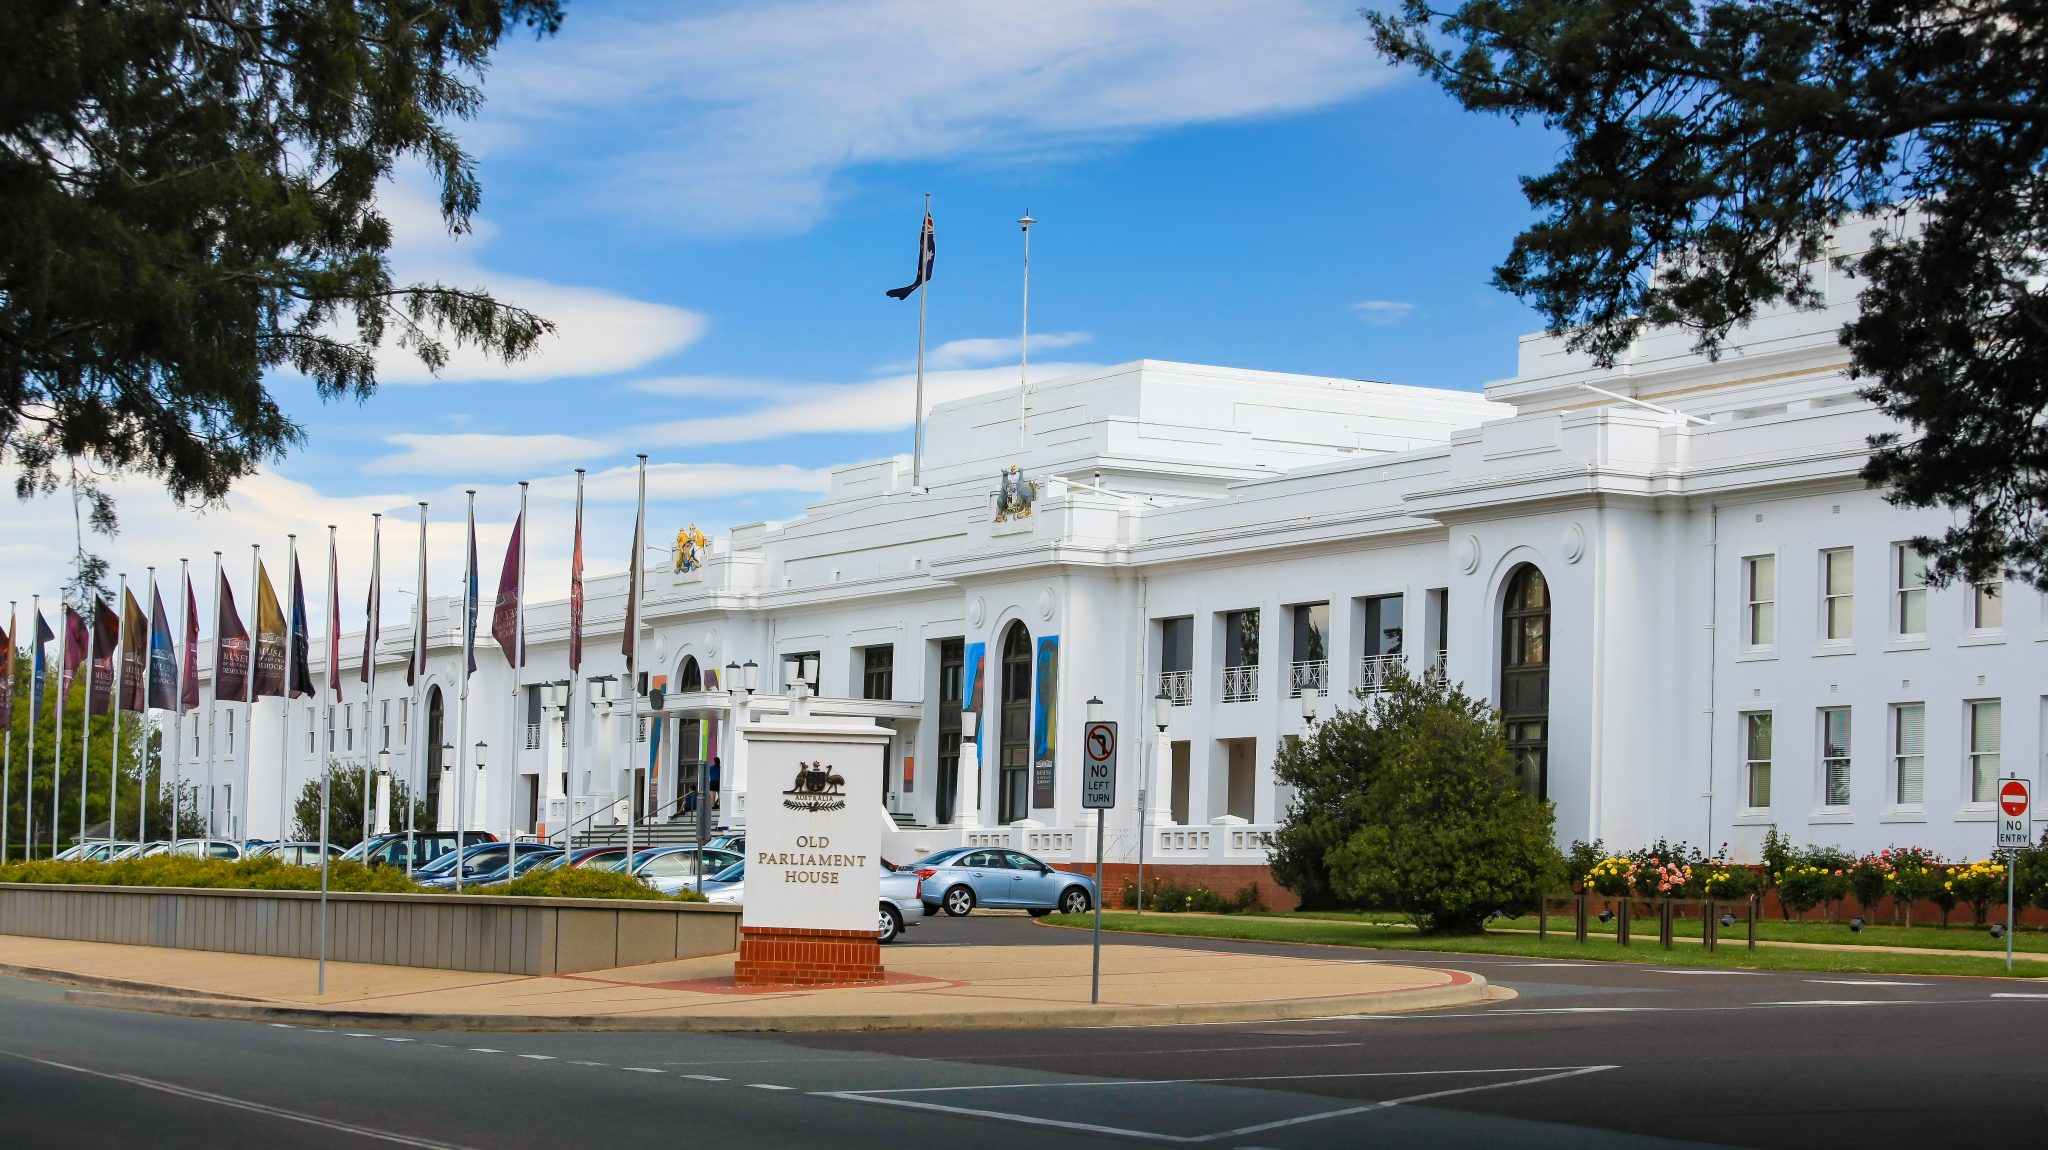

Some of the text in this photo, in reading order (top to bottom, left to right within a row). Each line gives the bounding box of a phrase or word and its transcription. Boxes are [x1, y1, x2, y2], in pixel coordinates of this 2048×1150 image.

[1091, 765, 1108, 778] NO
[1088, 781, 1110, 790] LEFT
[1088, 793, 1110, 803] TURN
[2006, 820, 2022, 831] NO
[796, 835, 830, 848] OLD
[2000, 833, 2028, 843] ENTRY
[758, 852, 867, 867] PARLIAMENT
[785, 871, 840, 884] HOUSE
